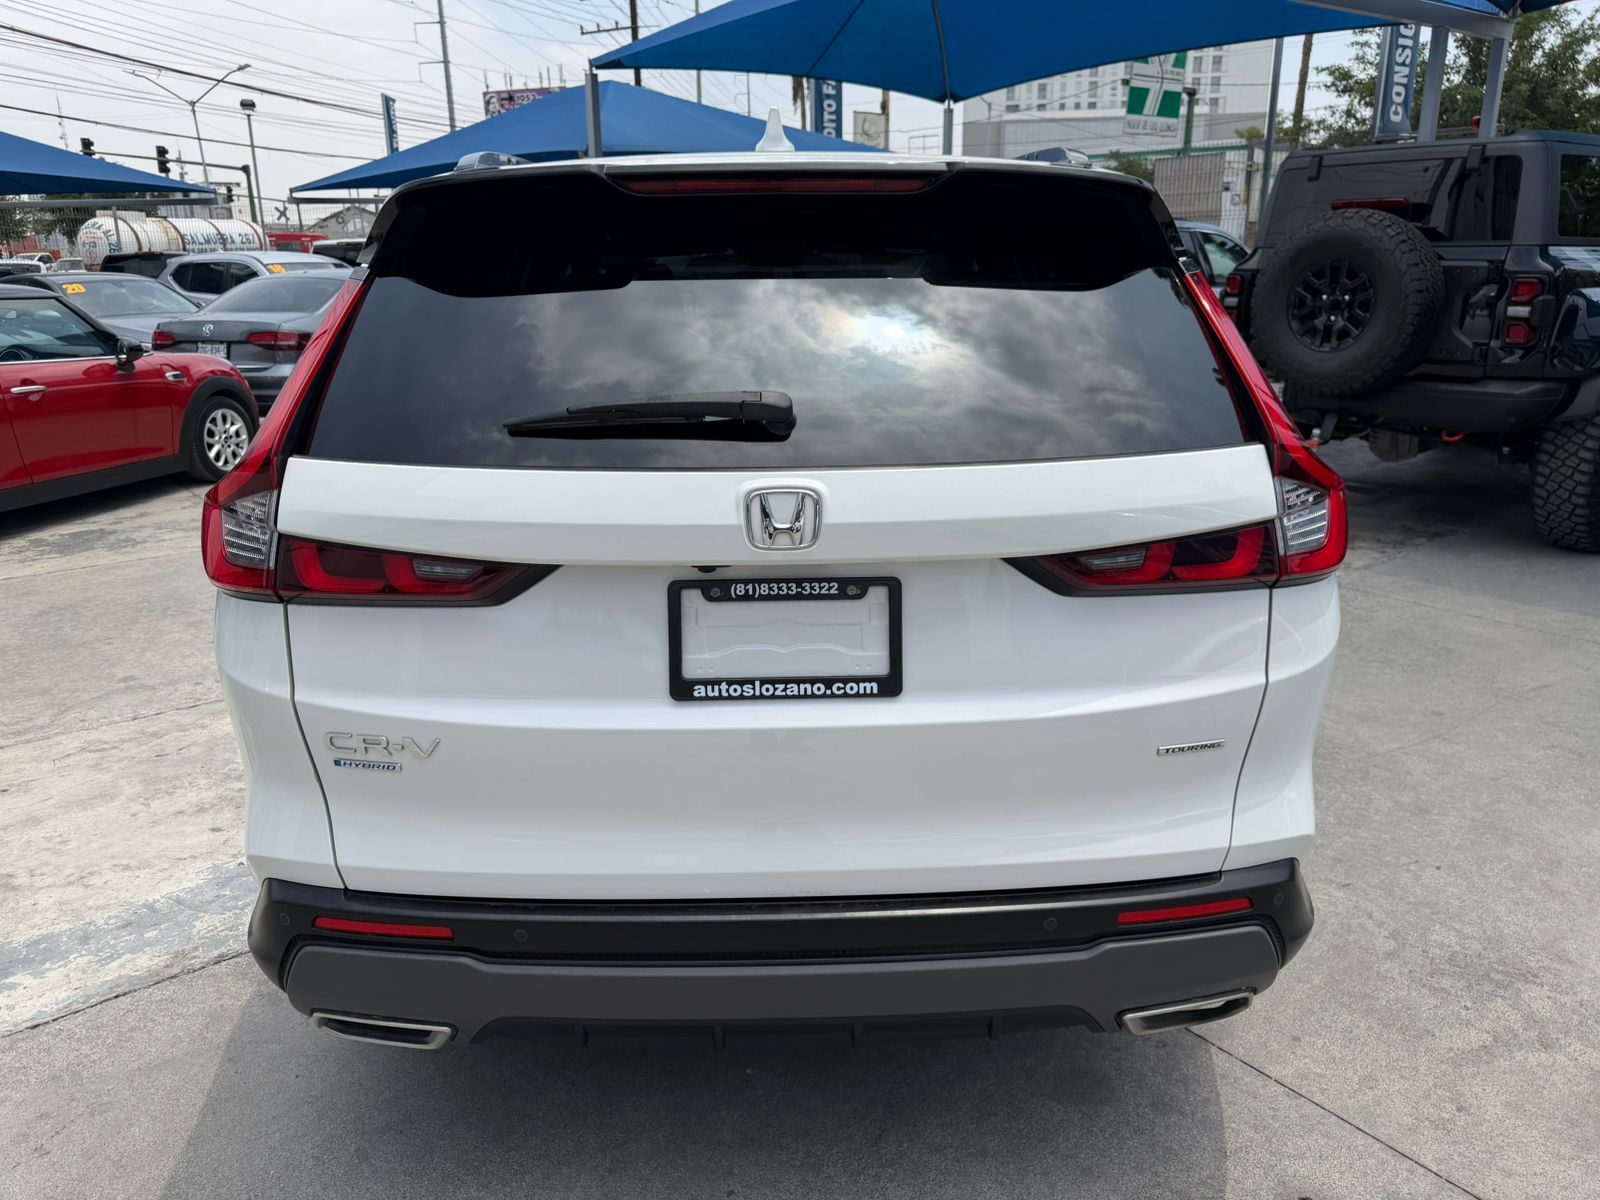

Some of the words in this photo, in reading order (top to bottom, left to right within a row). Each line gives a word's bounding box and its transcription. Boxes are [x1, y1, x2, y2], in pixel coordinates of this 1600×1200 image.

[730, 582, 839, 599] (81)8333-3322
[693, 681, 879, 698] autoslozano.com
[325, 731, 441, 759] CR-V
[1165, 743, 1221, 754] TOURING
[343, 761, 397, 771] HYBRID
